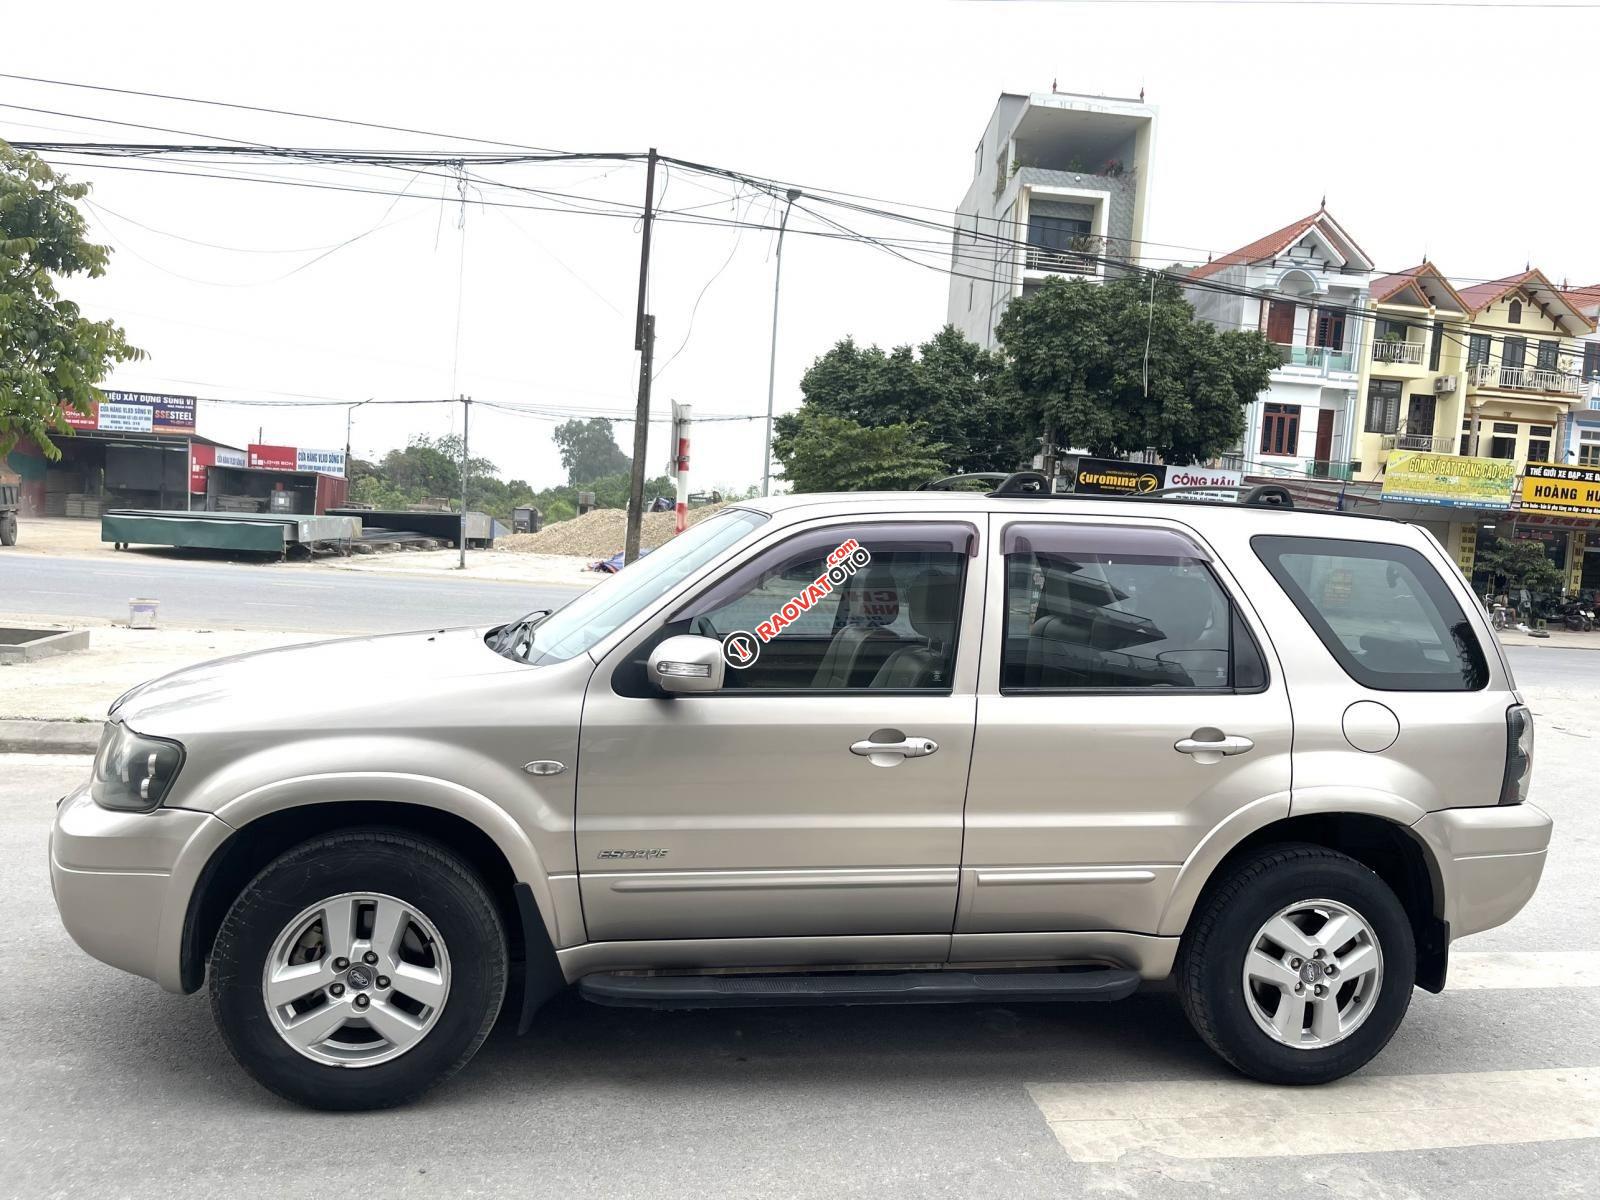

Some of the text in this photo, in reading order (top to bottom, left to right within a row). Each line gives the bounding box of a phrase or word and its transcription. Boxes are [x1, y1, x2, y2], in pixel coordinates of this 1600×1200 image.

[1172, 473, 1207, 486] CÔNG
[1558, 470, 1567, 478] XE
[1535, 484, 1578, 500] HOÀNG
